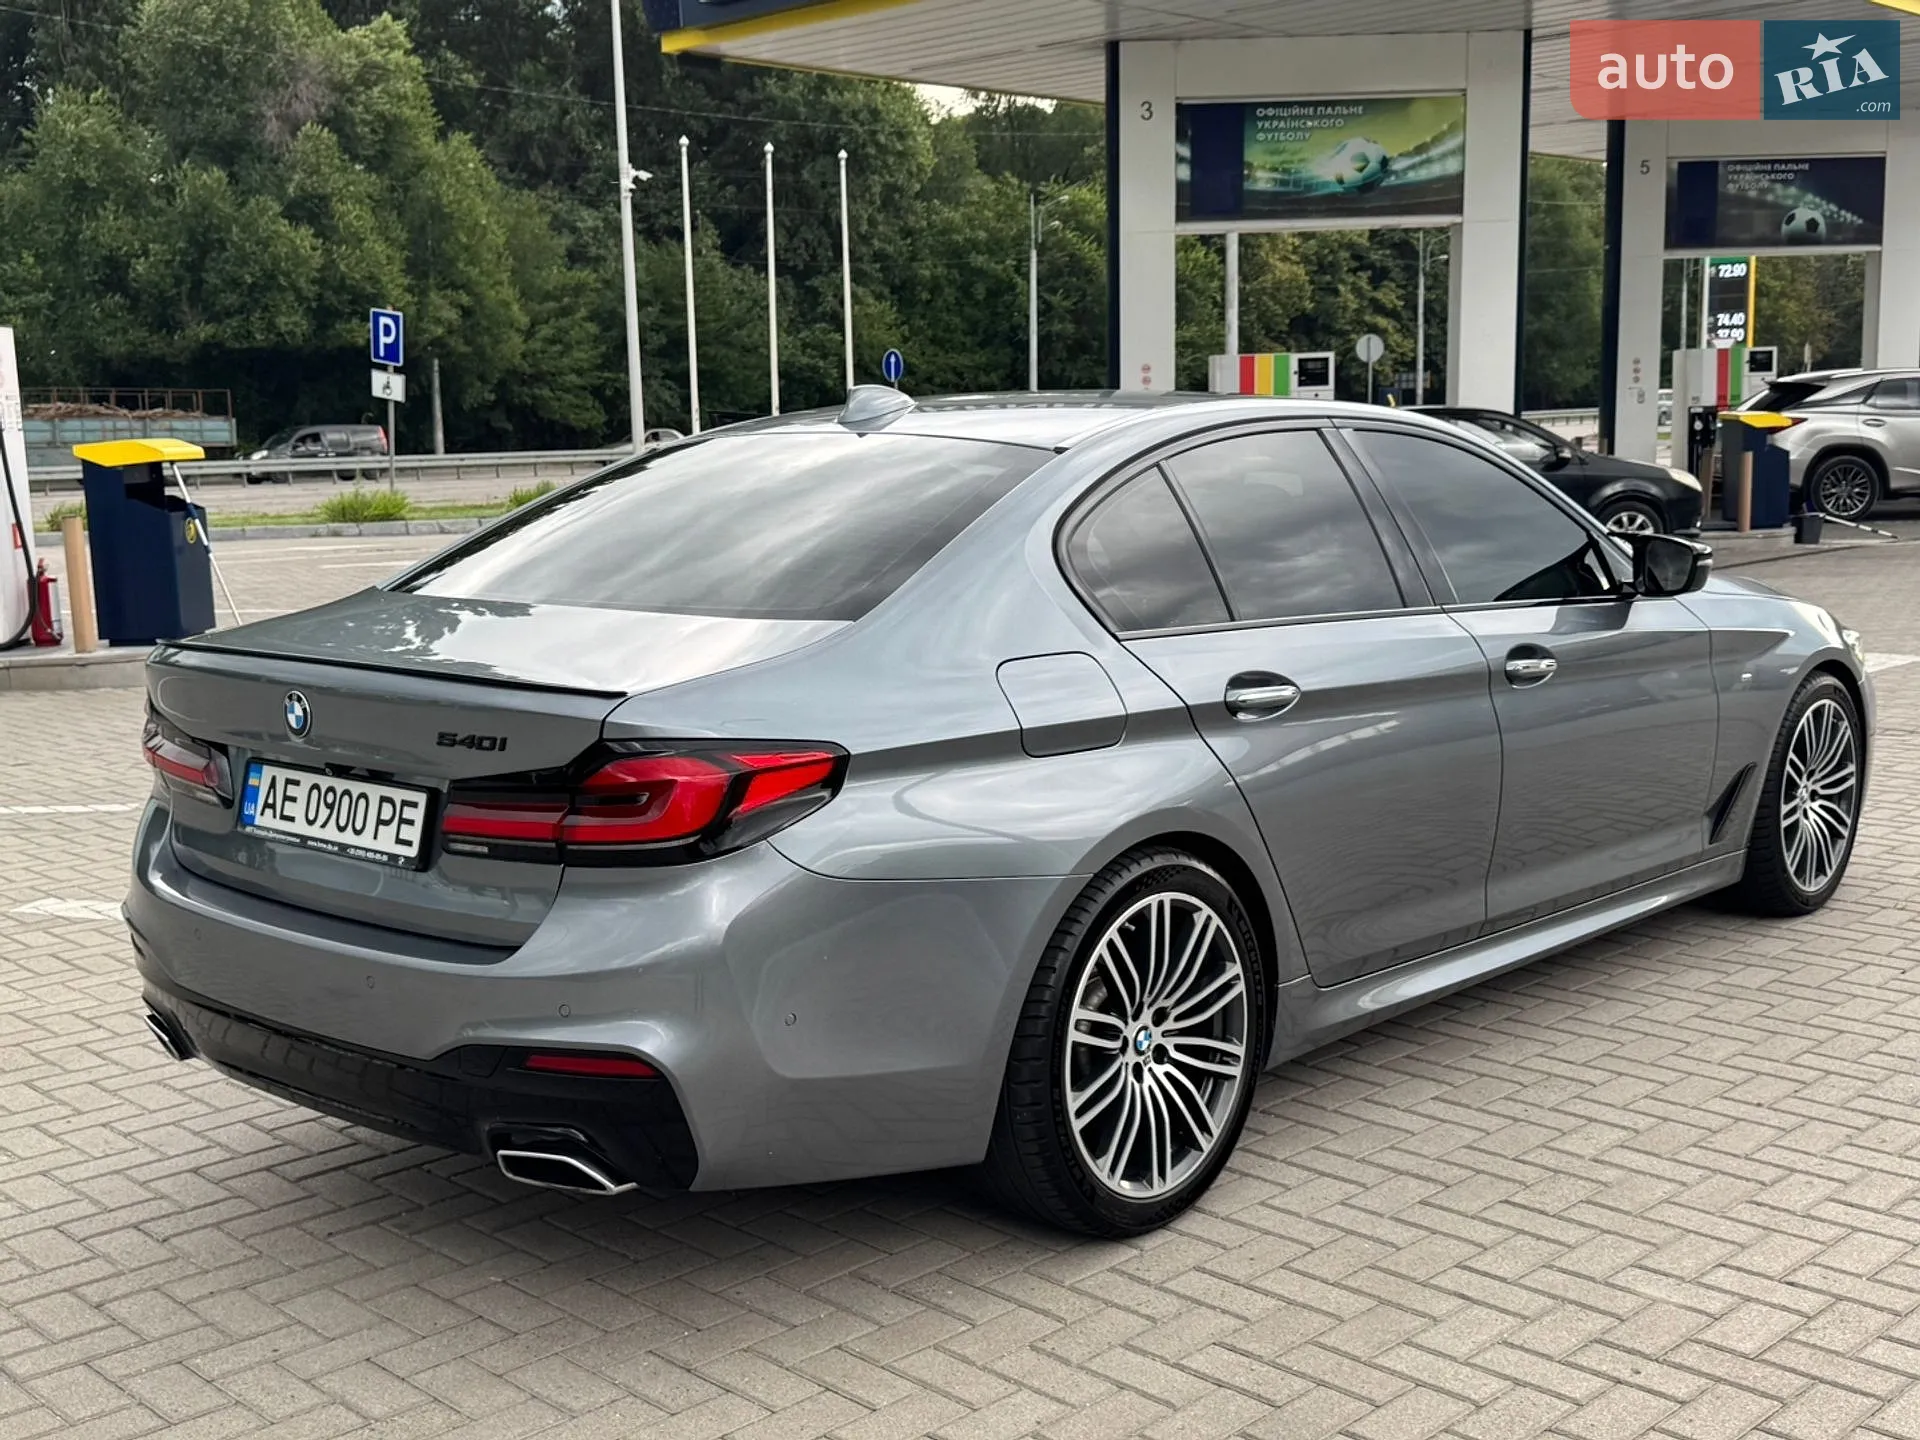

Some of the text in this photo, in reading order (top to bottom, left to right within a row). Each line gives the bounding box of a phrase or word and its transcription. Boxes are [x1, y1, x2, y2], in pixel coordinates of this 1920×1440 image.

[1141, 101, 1153, 121] 3
[1256, 105, 1364, 117] ОФІЦІЙНЕ ПАЛЬНЕ
[1256, 117, 1344, 129] УКРАЇНСЬКОГО
[1256, 131, 1311, 141] ФУТБОЛУ
[1640, 160, 1651, 175] 5
[378, 315, 397, 358] P
[243, 801, 256, 817] UA
[260, 774, 420, 848] AE 0900 PE
